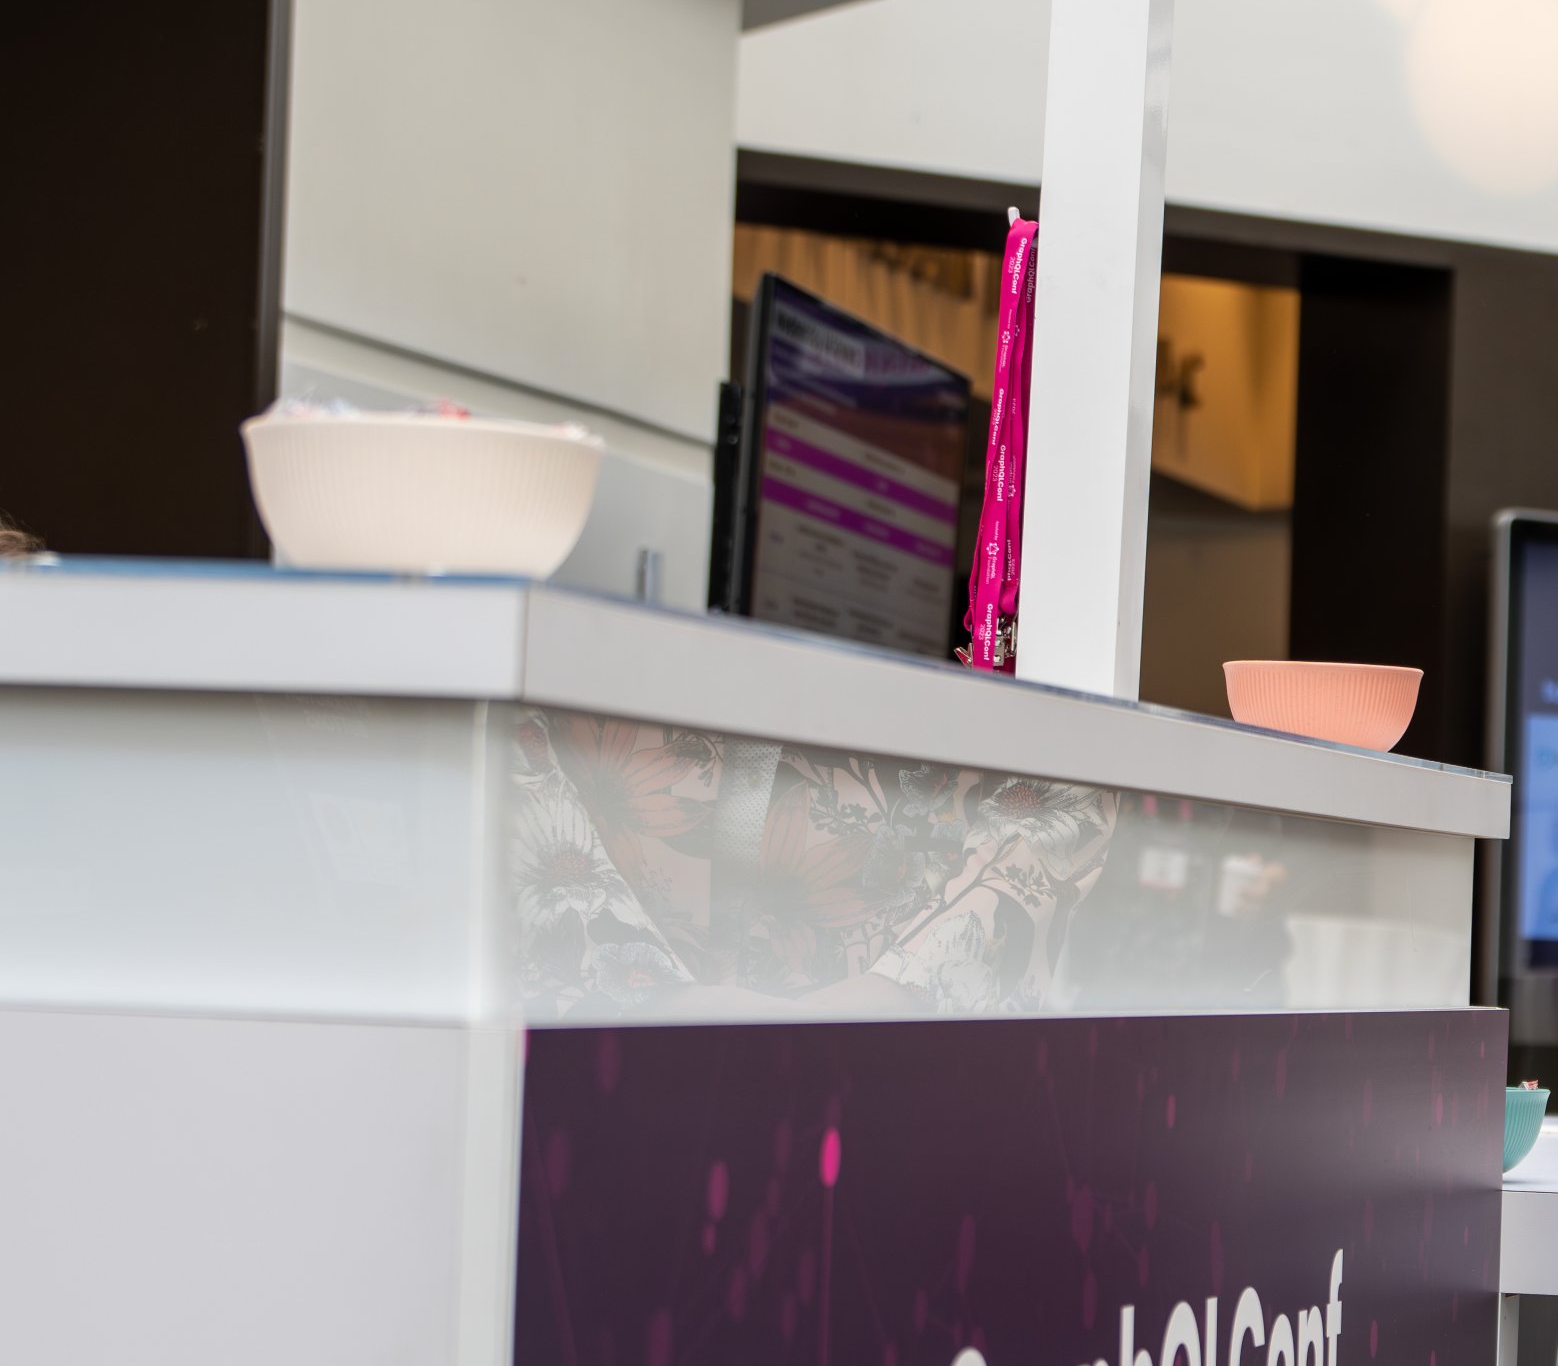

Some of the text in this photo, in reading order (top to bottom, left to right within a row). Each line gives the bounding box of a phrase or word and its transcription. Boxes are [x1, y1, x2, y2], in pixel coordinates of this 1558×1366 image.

[1011, 237, 1027, 294] GraphQLConf
[997, 444, 1006, 502] GraphQLConf
[984, 603, 994, 661] GraphQLConf
